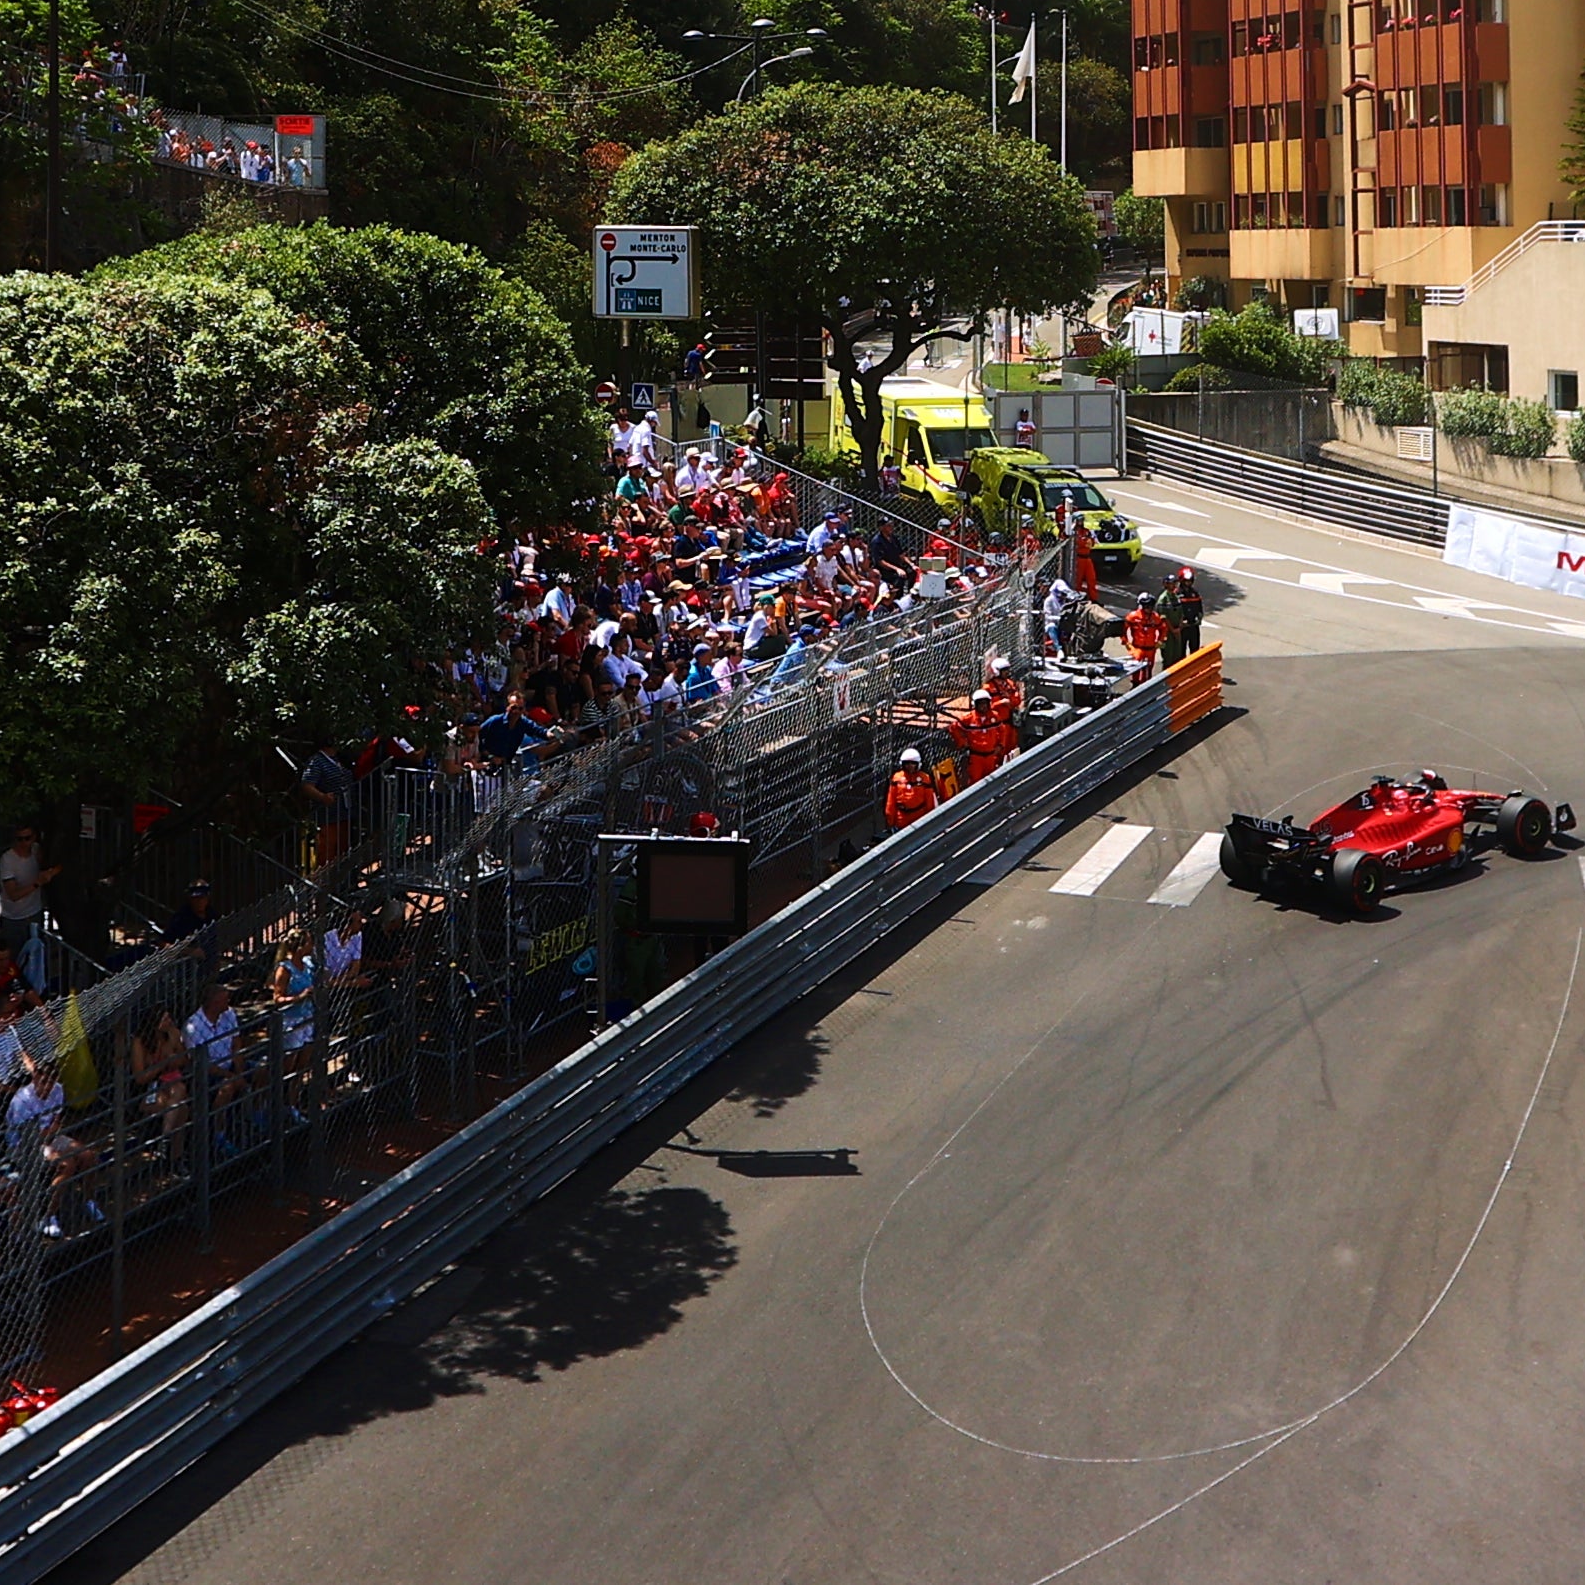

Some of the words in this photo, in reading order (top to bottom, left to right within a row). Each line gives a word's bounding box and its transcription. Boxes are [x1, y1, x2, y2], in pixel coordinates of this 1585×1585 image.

[640, 234, 675, 242] MENTON
[630, 244, 686, 253] MONTE-CARLO
[637, 296, 660, 306] NICE
